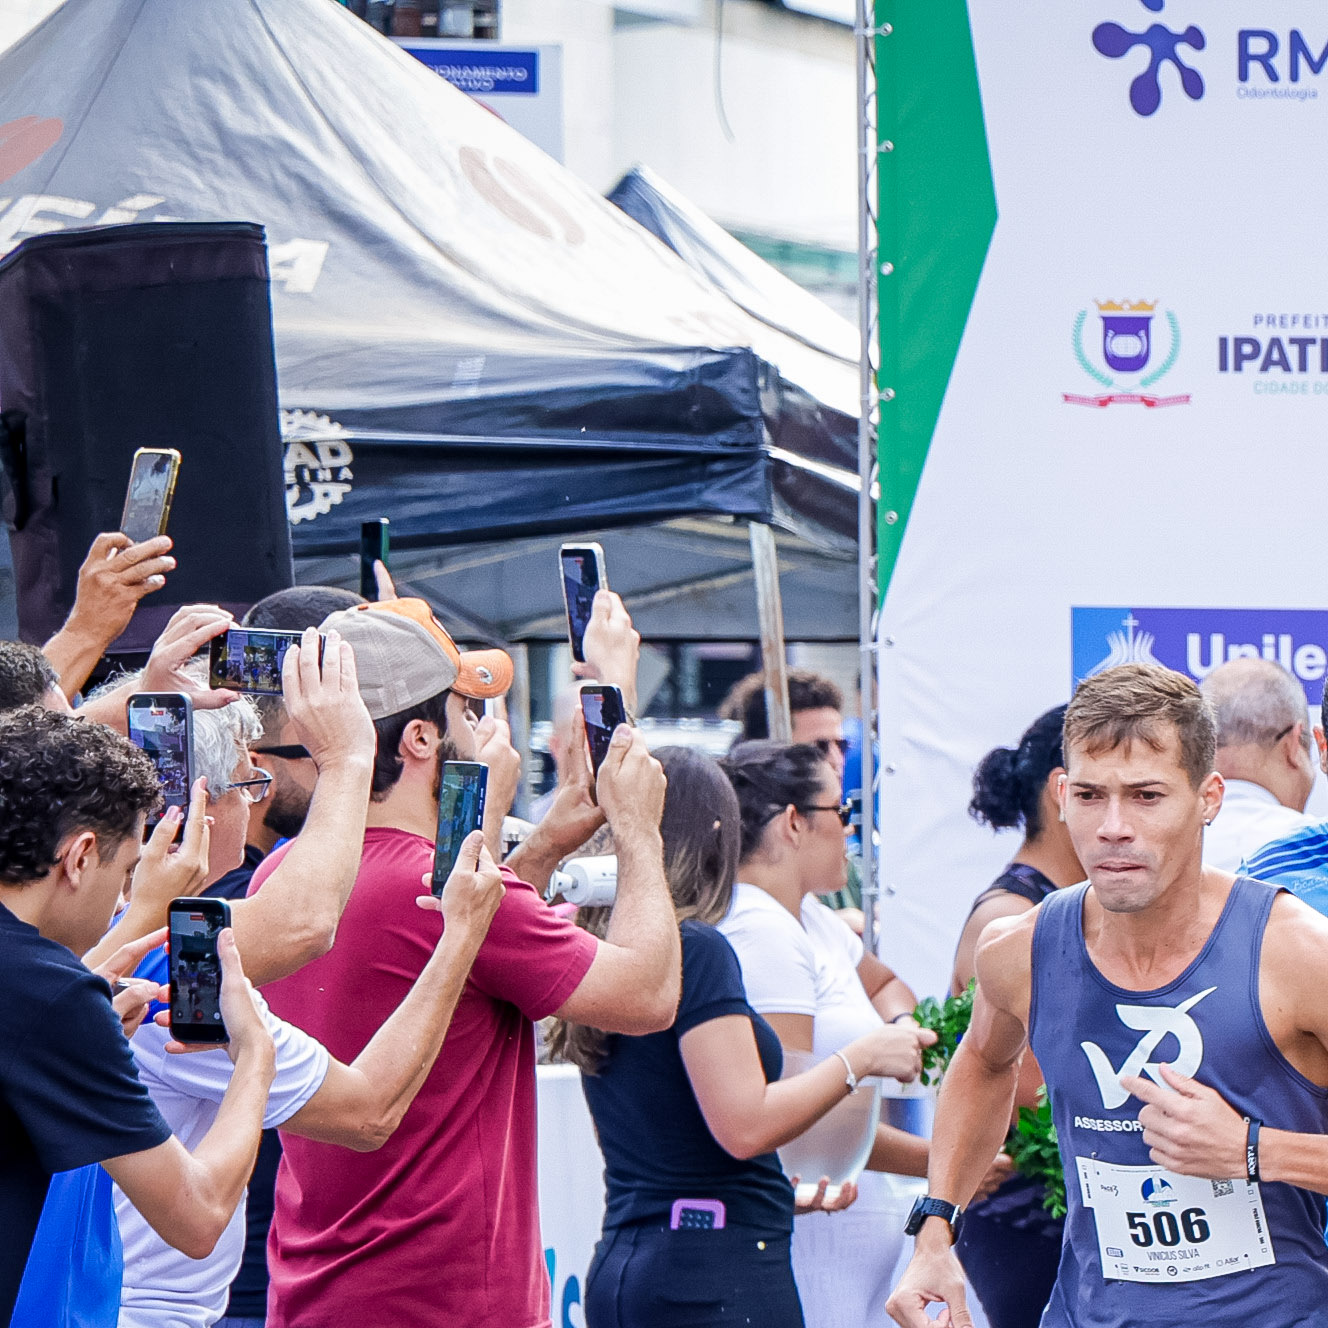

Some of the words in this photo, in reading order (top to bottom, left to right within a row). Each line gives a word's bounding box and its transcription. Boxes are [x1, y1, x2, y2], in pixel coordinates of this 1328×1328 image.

[427, 65, 528, 82] IONAMENTO
[1237, 88, 1318, 101] Odontologia
[1253, 381, 1308, 395] CIDADE
[1075, 1116, 1144, 1132] ASSESSOR
[1126, 1208, 1211, 1247] 506
[1147, 1250, 1177, 1261] VINICIUS
[1177, 1248, 1200, 1260] SILVA
